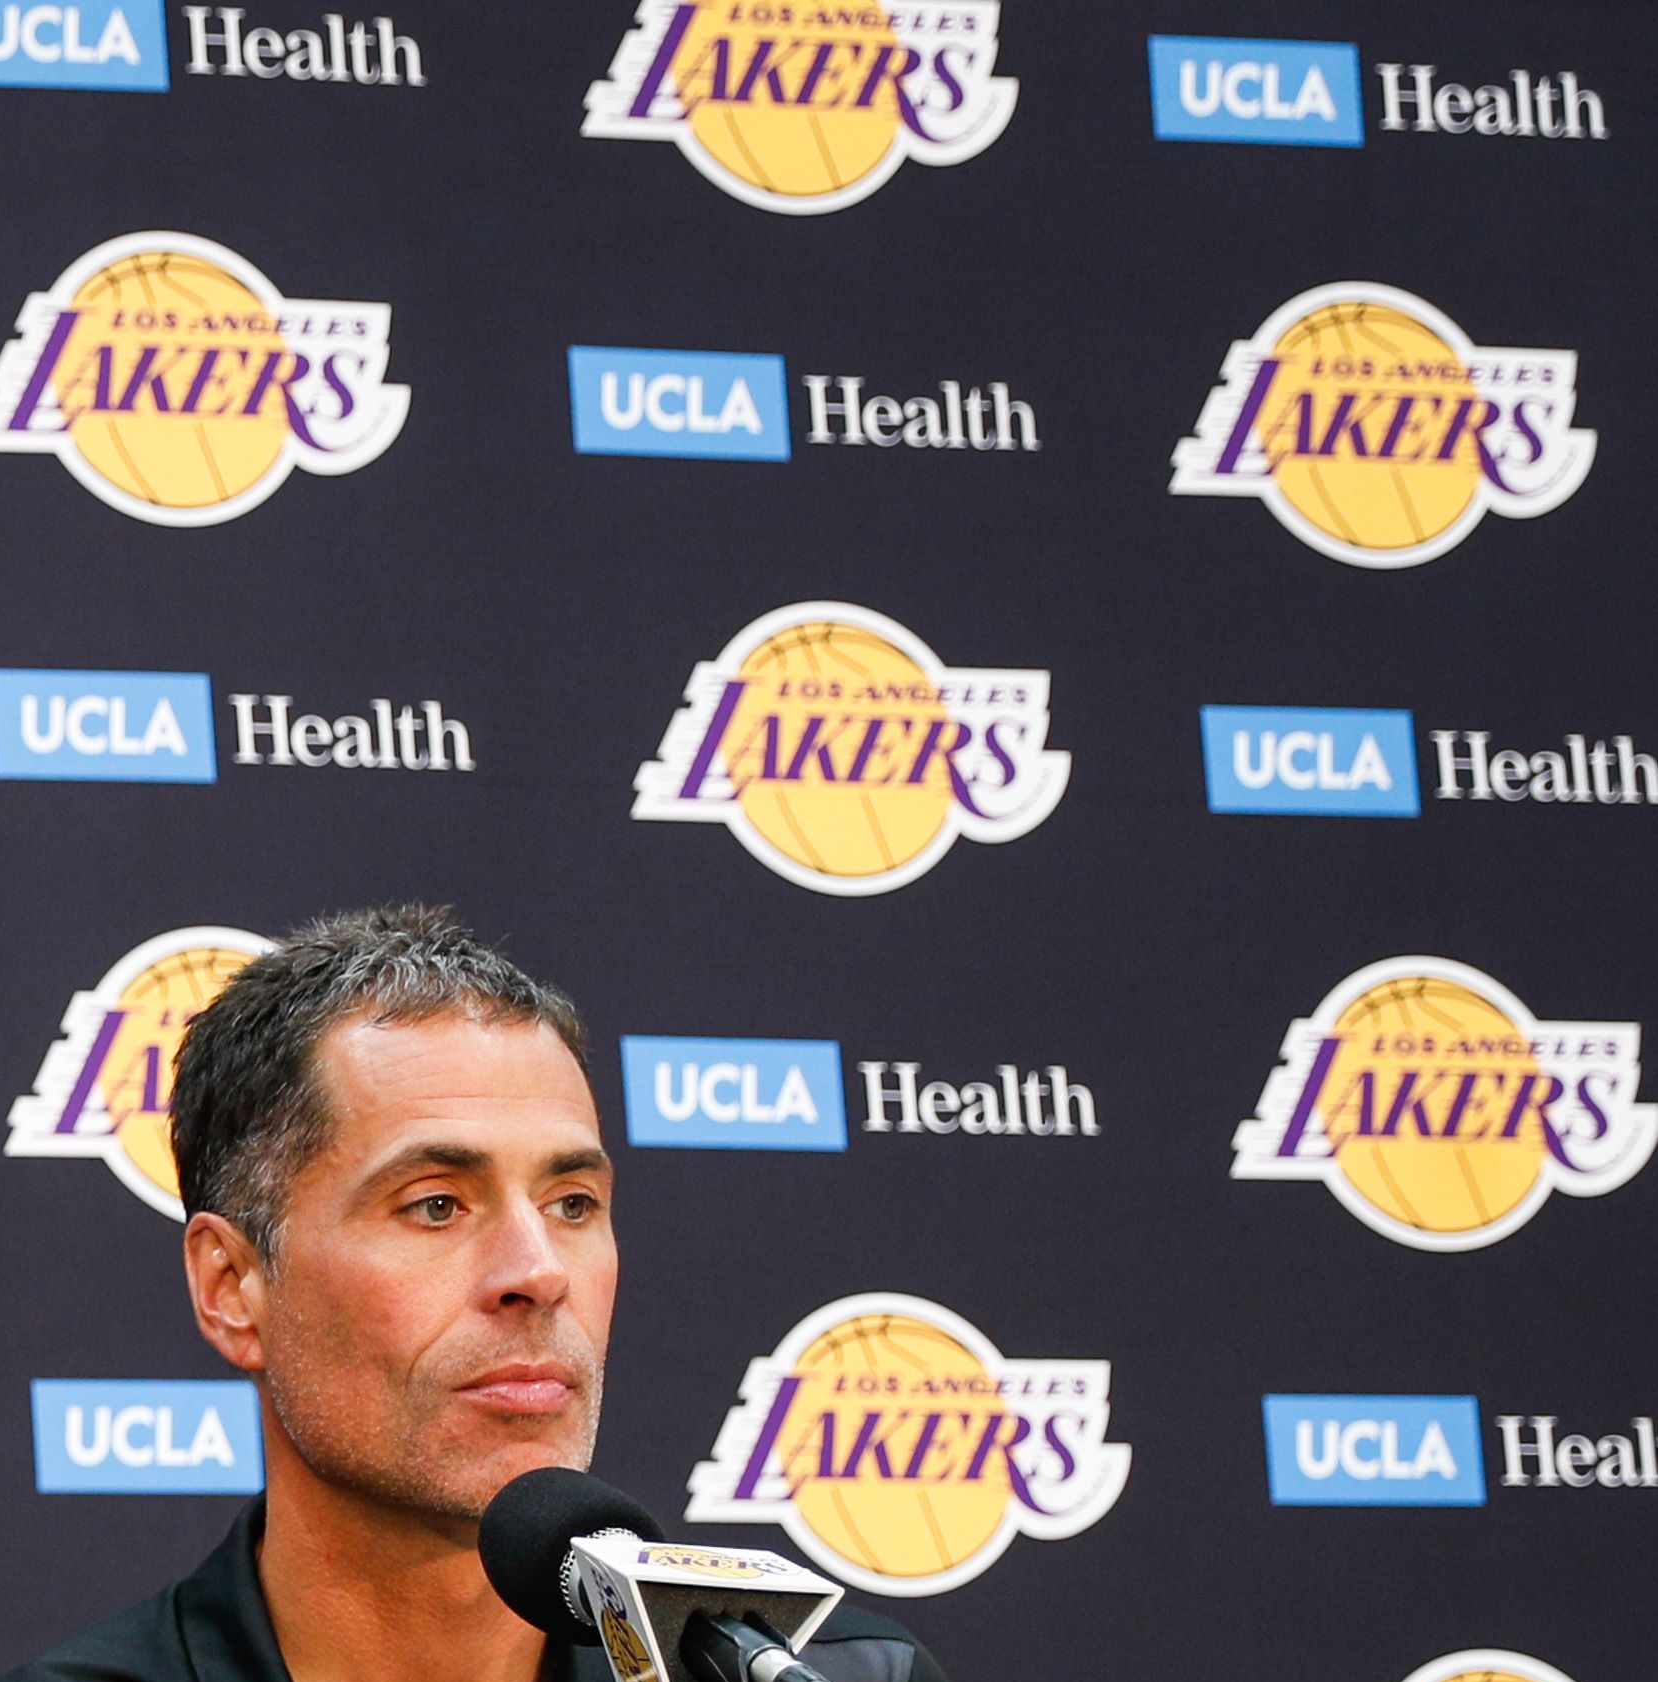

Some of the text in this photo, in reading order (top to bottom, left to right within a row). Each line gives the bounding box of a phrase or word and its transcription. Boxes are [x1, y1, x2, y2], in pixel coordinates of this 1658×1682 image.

[186, 6, 425, 87] Health
[729, 4, 976, 31] LOS ANGELES
[625, 1, 978, 144] LAKERS
[1180, 60, 1606, 140] UCLA Health
[111, 310, 367, 335] LOS ANGELES
[5, 309, 369, 452] LAKERS
[1311, 358, 1554, 383] LOS ANGELES
[600, 371, 1039, 451] UCLA Health
[1212, 356, 1556, 497] LAKERS
[778, 679, 1027, 704] LOS ANGELES
[19, 693, 475, 772] UCLA Health
[676, 678, 1029, 821] LAKERS
[1233, 730, 1658, 804] UCLA Health
[1372, 1035, 1617, 1057] LOS ANGELES
[653, 1060, 1100, 1136] UCLA Health
[1274, 1034, 1620, 1174] LAKERS
[834, 1373, 1087, 1395] LOS ANGELES
[64, 1403, 238, 1469] UCLA
[730, 1373, 1089, 1516] LAKERS
[1295, 1416, 1658, 1487] UCLA Heal
[637, 1548, 789, 1578] LAKERS
